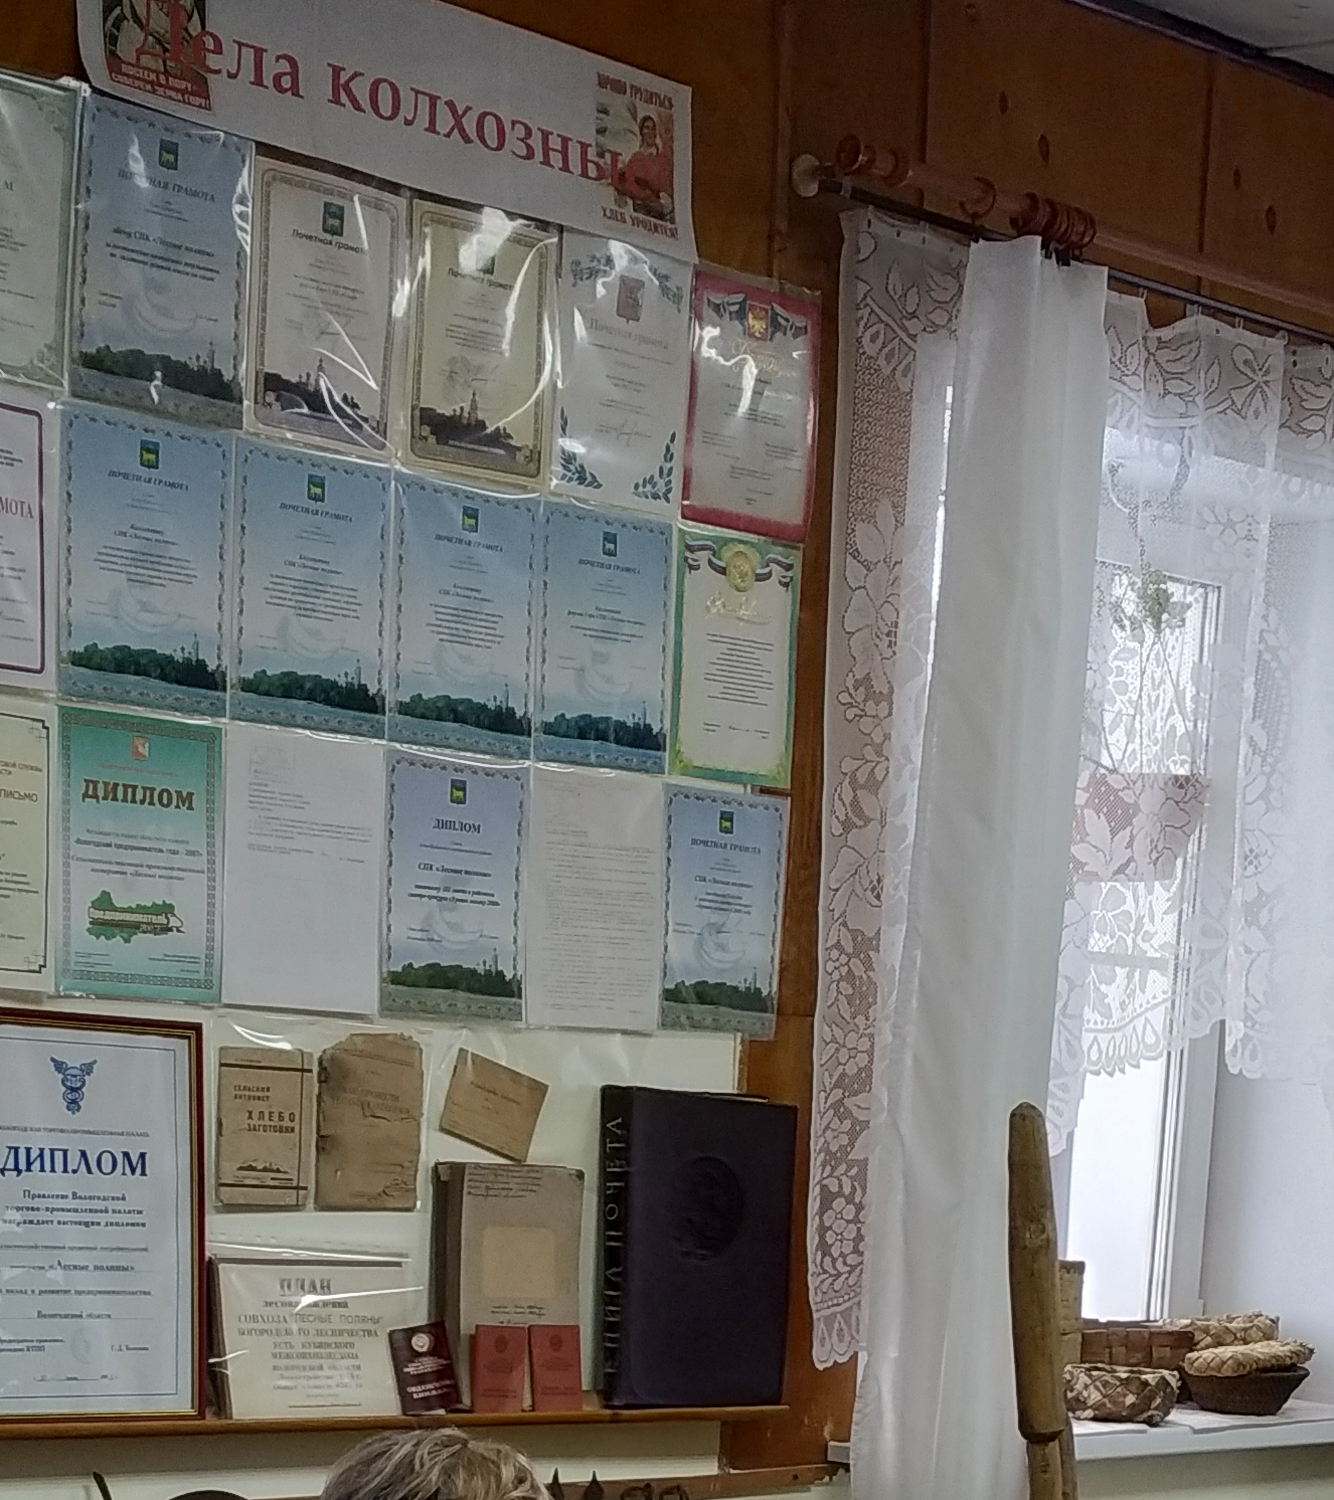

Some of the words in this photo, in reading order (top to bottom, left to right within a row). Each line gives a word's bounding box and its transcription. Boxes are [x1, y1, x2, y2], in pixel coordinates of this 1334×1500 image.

[135, 0, 305, 99] Дела
[117, 169, 169, 192] ПОНАЯ
[172, 181, 216, 204] ГРАМОТА
[0, 788, 38, 803] ПИСЬМО
[81, 778, 195, 811] ДИПЛОМ
[431, 818, 482, 834] ДИПЛОМ
[690, 837, 728, 850] ПОЧЕТНАЯ
[729, 843, 761, 855] ГРАМОТА
[246, 1110, 296, 1123] ХЛЕБО
[246, 1123, 295, 1134] ЗАГОТОВКИ
[604, 1117, 627, 1247] ПОЧЕТА
[22, 1189, 70, 1202] Правление
[71, 1191, 127, 1202] Вологодской
[48, 1259, 90, 1271] «Лесные
[278, 1277, 332, 1297] ПЛАН
[238, 1314, 288, 1324] СОВХОЗА
[237, 1328, 310, 1337] БОГОРОДСКГО
[313, 1328, 379, 1337] ЛЕСНИЧЕСТВА
[273, 1341, 295, 1349] УСТЬ
[301, 1341, 355, 1349] КУБИНСКОГО
